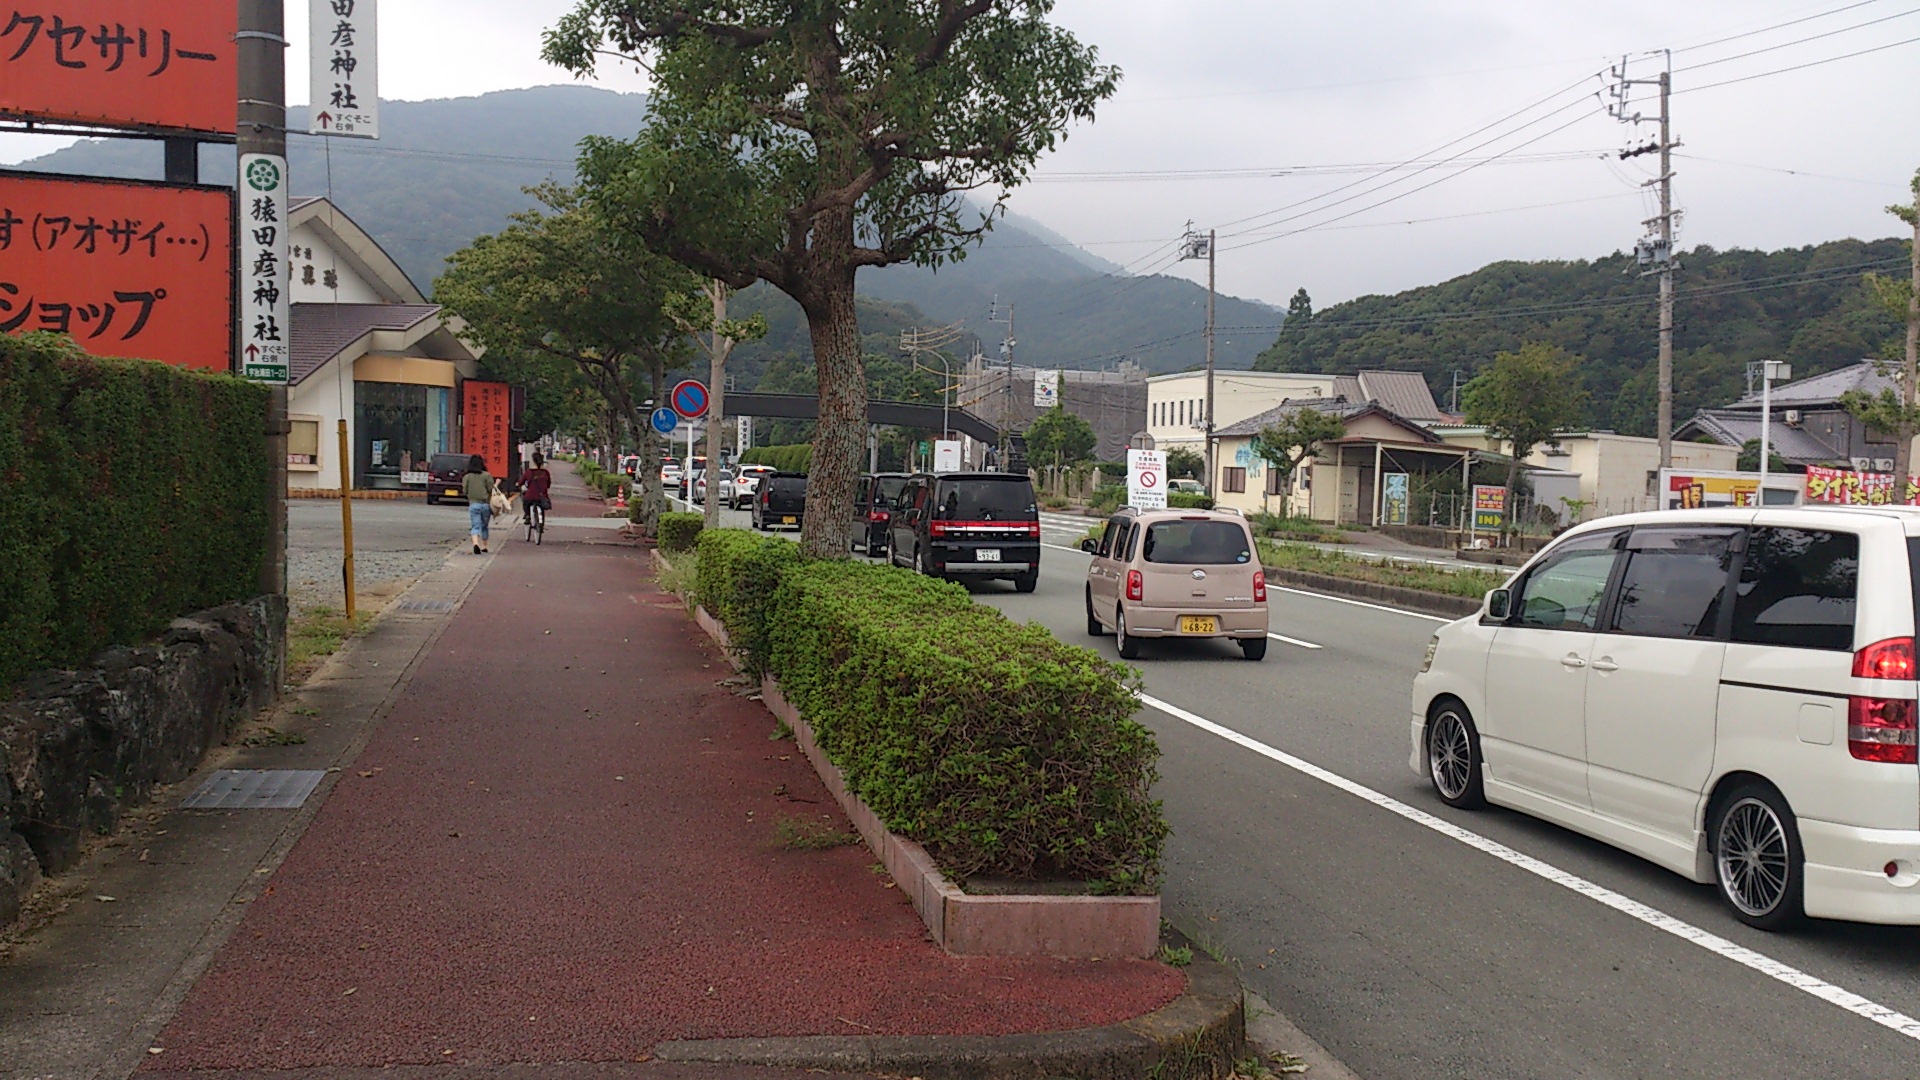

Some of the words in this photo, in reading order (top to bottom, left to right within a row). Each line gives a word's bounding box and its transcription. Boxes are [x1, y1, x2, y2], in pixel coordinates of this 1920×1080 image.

[0, 11, 217, 77] クセサリー
[335, 113, 371, 124] すぐそこ
[335, 122, 354, 132] 右側
[250, 195, 282, 342] 猿田彦神社
[0, 282, 168, 341] ショップ
[261, 345, 287, 355] すぐそこ
[261, 354, 278, 363] 右側
[1478, 514, 1494, 525] IN
[1188, 622, 1214, 632] 68-22
